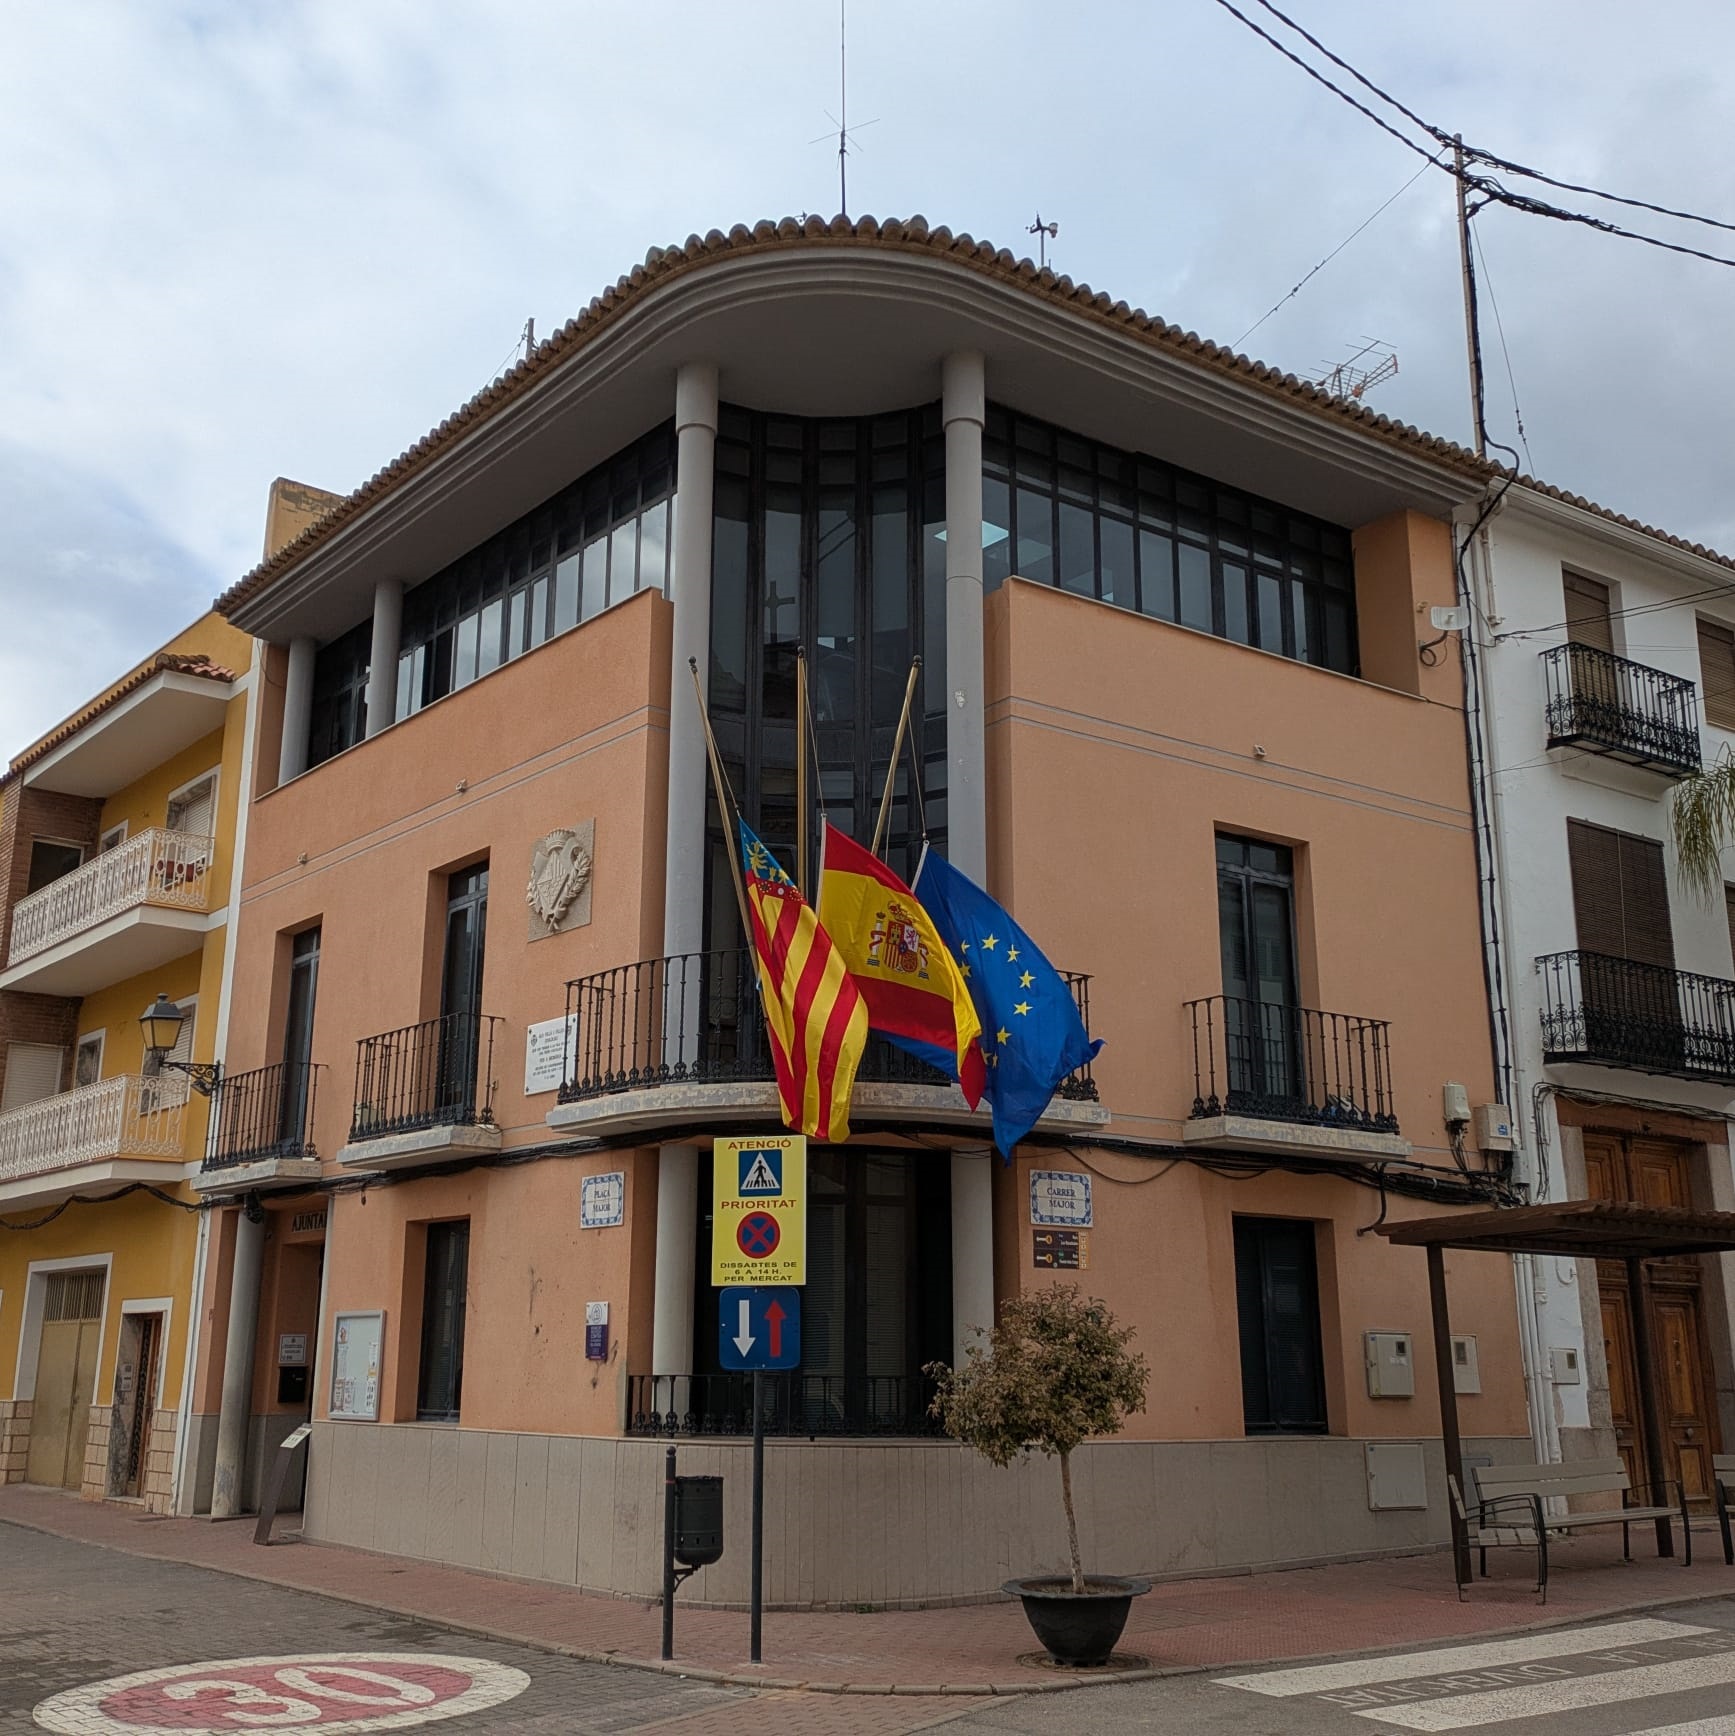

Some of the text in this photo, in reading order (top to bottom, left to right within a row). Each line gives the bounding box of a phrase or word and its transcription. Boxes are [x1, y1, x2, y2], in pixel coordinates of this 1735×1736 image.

[728, 1138, 791, 1150] ATENCIÓ
[1046, 1187, 1076, 1197] CARRER
[721, 1200, 797, 1209] PRIORITAT
[1049, 1200, 1076, 1209] MAJOR
[291, 1211, 327, 1232] AJUNTA
[1316, 1664, 1575, 1709] DIVERSITAT
[162, 1667, 436, 1724] 30
